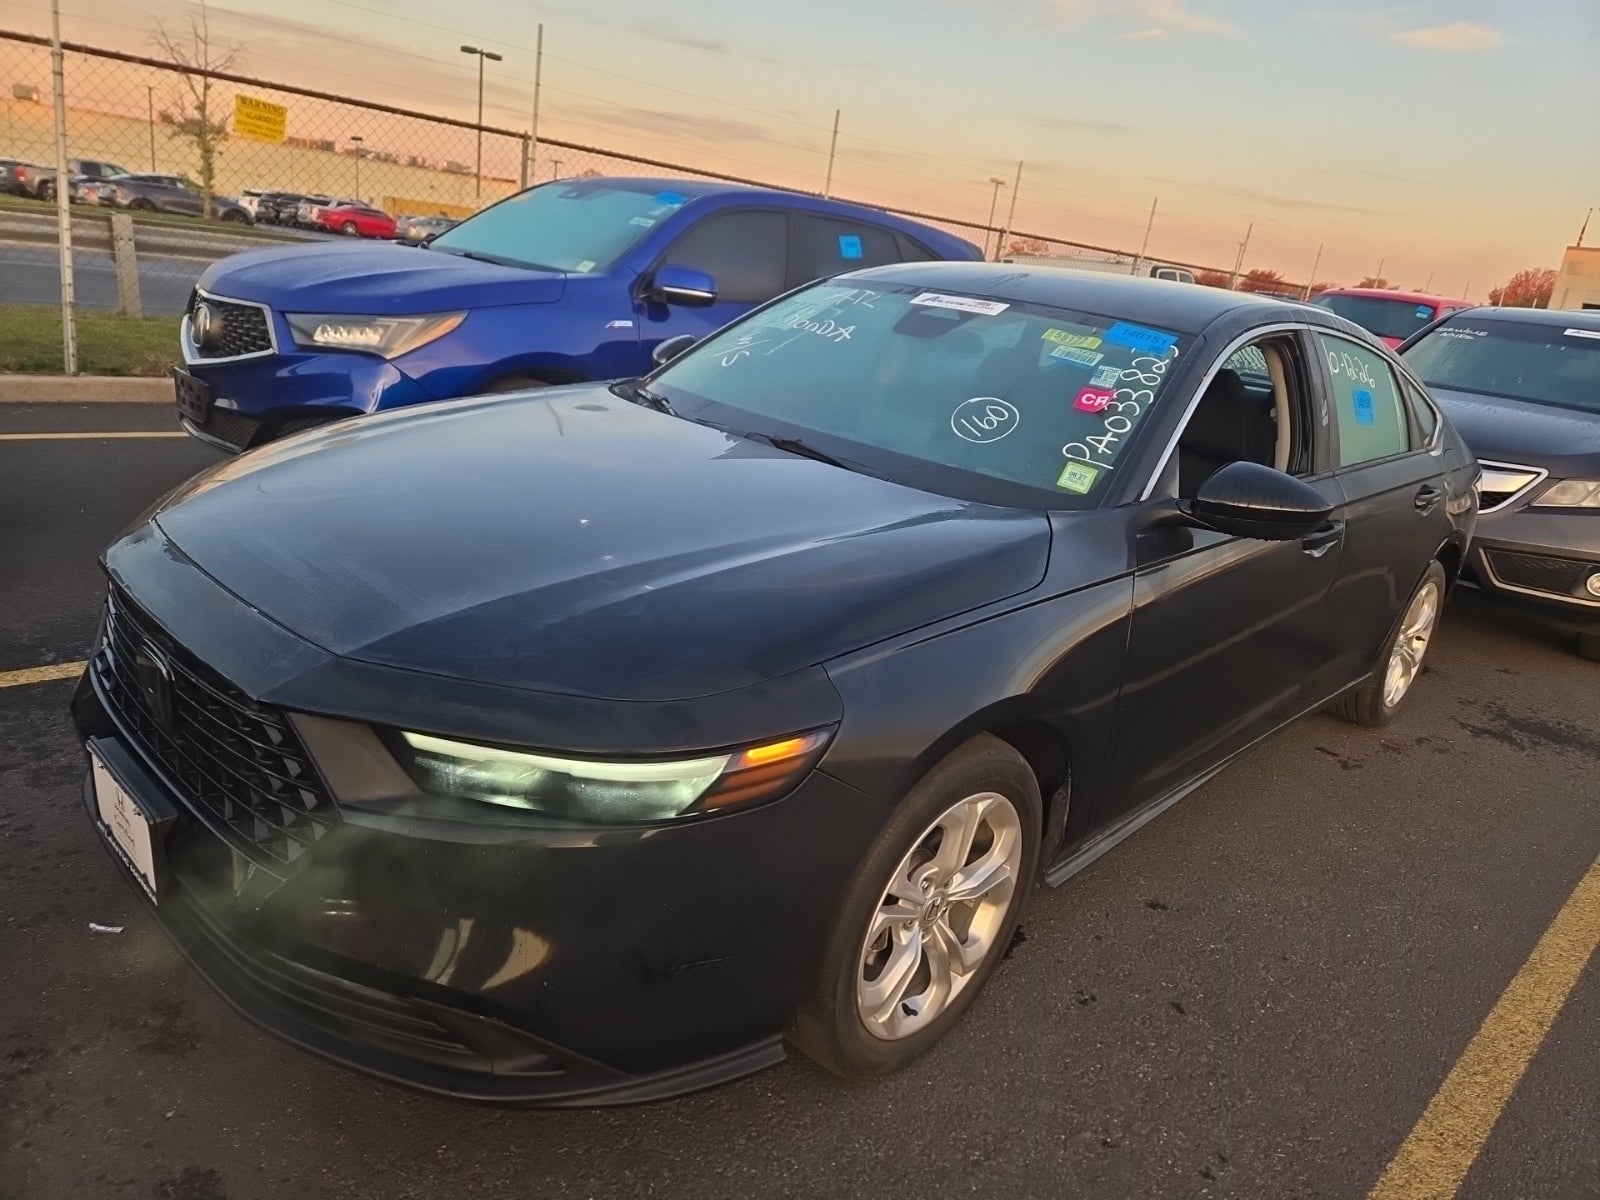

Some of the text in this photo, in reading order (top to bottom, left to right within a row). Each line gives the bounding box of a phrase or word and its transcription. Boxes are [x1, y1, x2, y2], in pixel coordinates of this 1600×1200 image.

[240, 95, 284, 115] WARNING
[960, 405, 1009, 437] 160
[1062, 344, 1179, 470] PA03382
